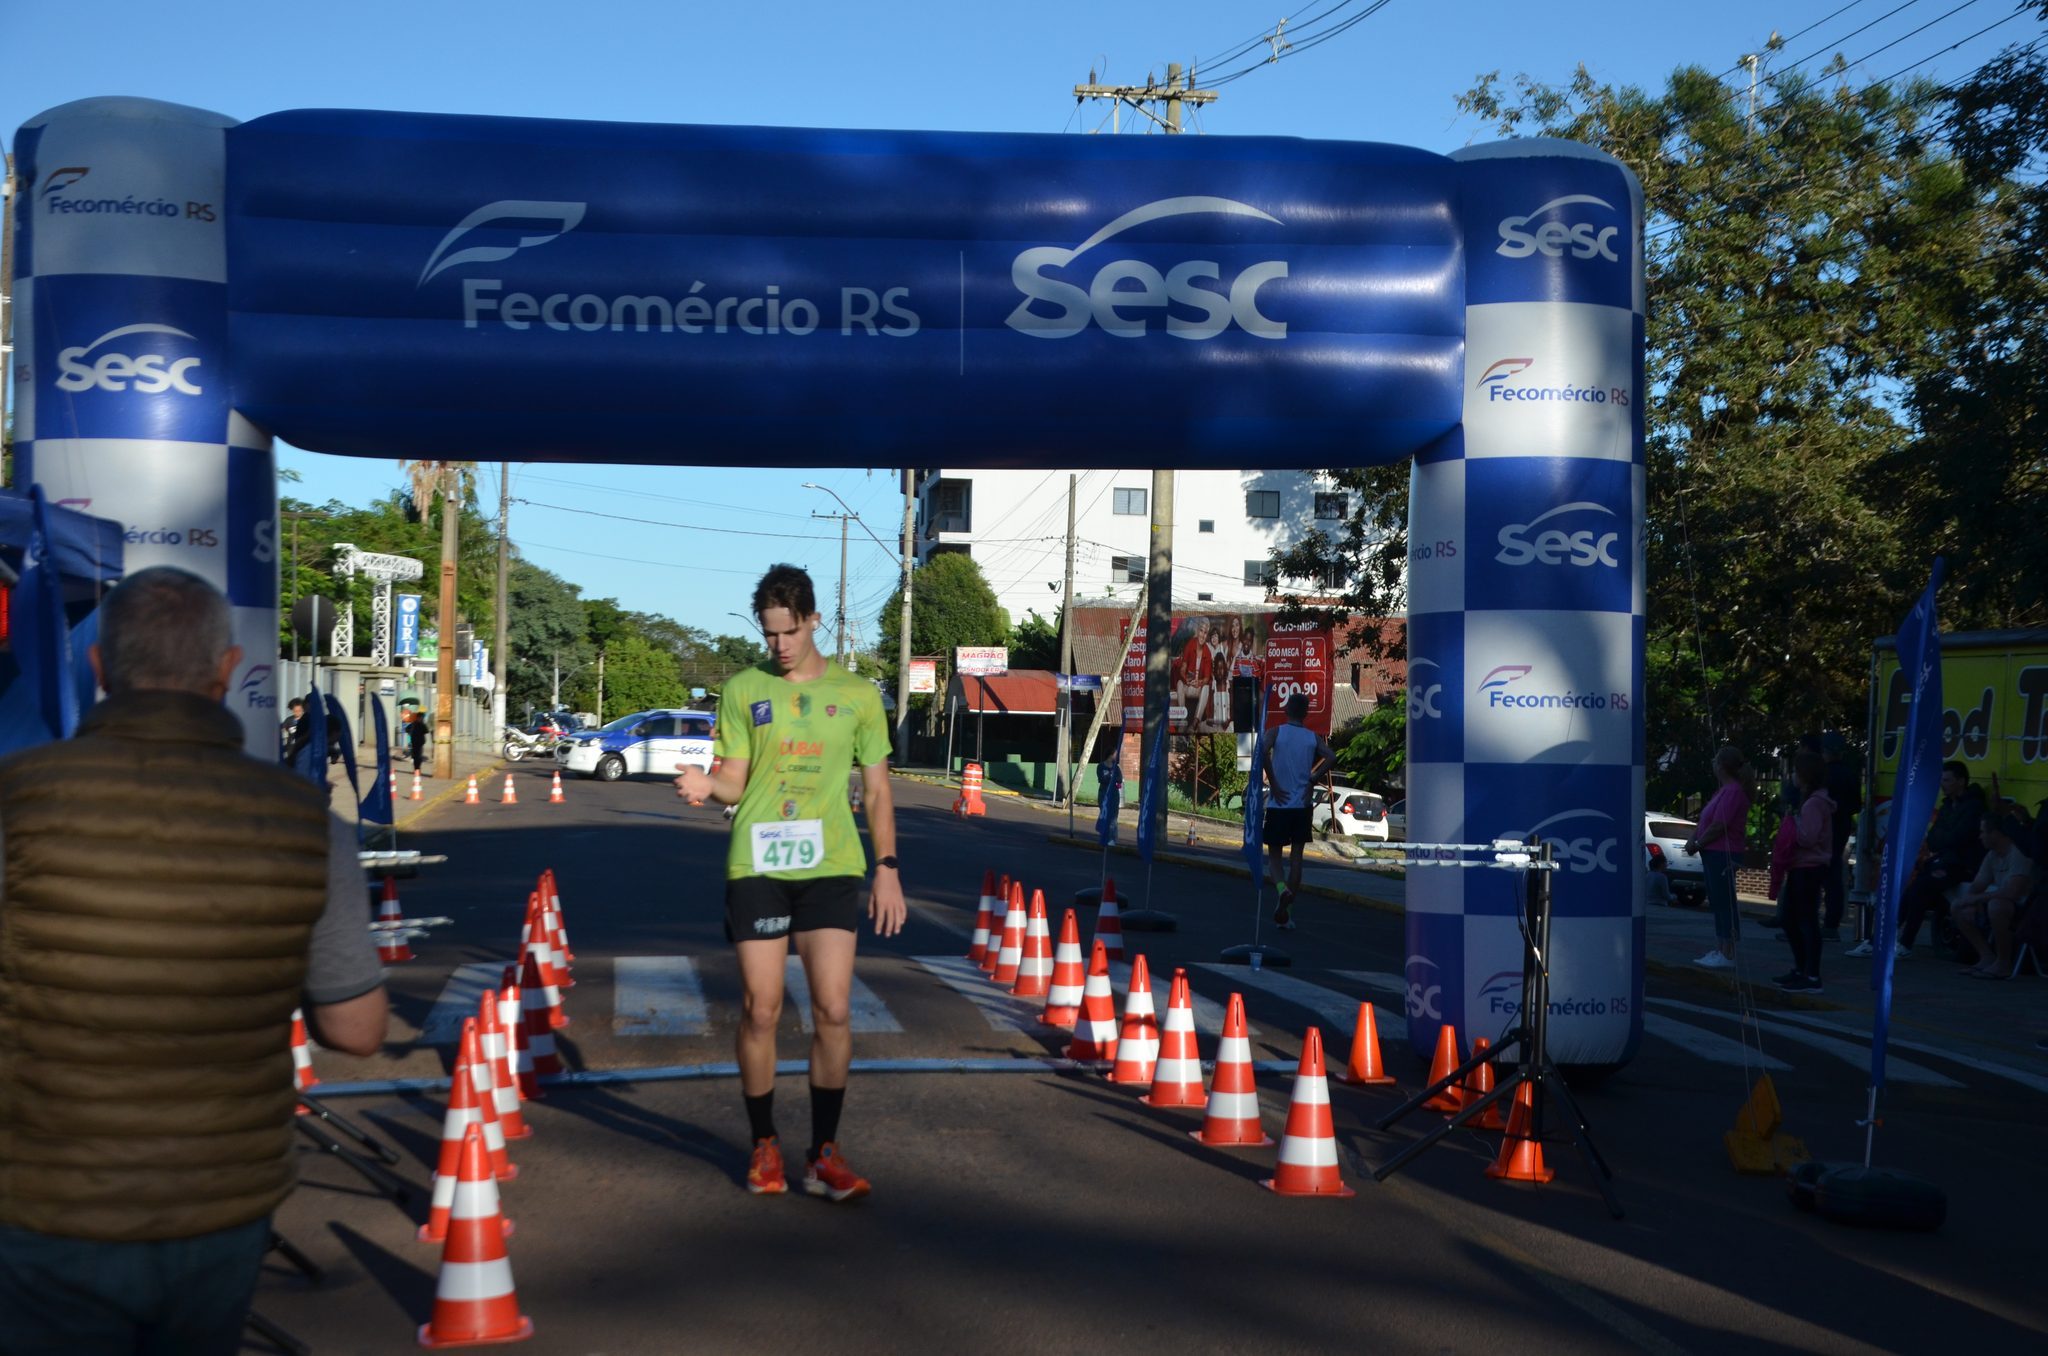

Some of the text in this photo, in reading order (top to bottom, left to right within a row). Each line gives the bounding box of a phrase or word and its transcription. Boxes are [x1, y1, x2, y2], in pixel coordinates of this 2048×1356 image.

[50, 194, 216, 222] Fecomércio RS
[1495, 216, 1618, 262] Sesc
[463, 246, 1288, 339] Fecomércio RS Sesc
[55, 345, 202, 395] Sesc
[1490, 384, 1629, 406] Fecomércio RS
[123, 525, 218, 547] ércio RS
[1435, 540, 1457, 558] RS
[1495, 524, 1617, 567] Sesc
[401, 614, 416, 653] URI
[1268, 648, 1299, 657] 600 MEGA
[1305, 647, 1315, 656] 60
[1305, 658, 1321, 667] GIGA
[1406, 684, 1442, 719] sc
[1490, 691, 1629, 711] Fecomércio RS
[1883, 667, 1994, 761] Fod
[780, 740, 824, 757] DUBAI
[763, 838, 815, 867] 479
[1406, 983, 1442, 1020] sc
[1611, 997, 1629, 1014] RS
